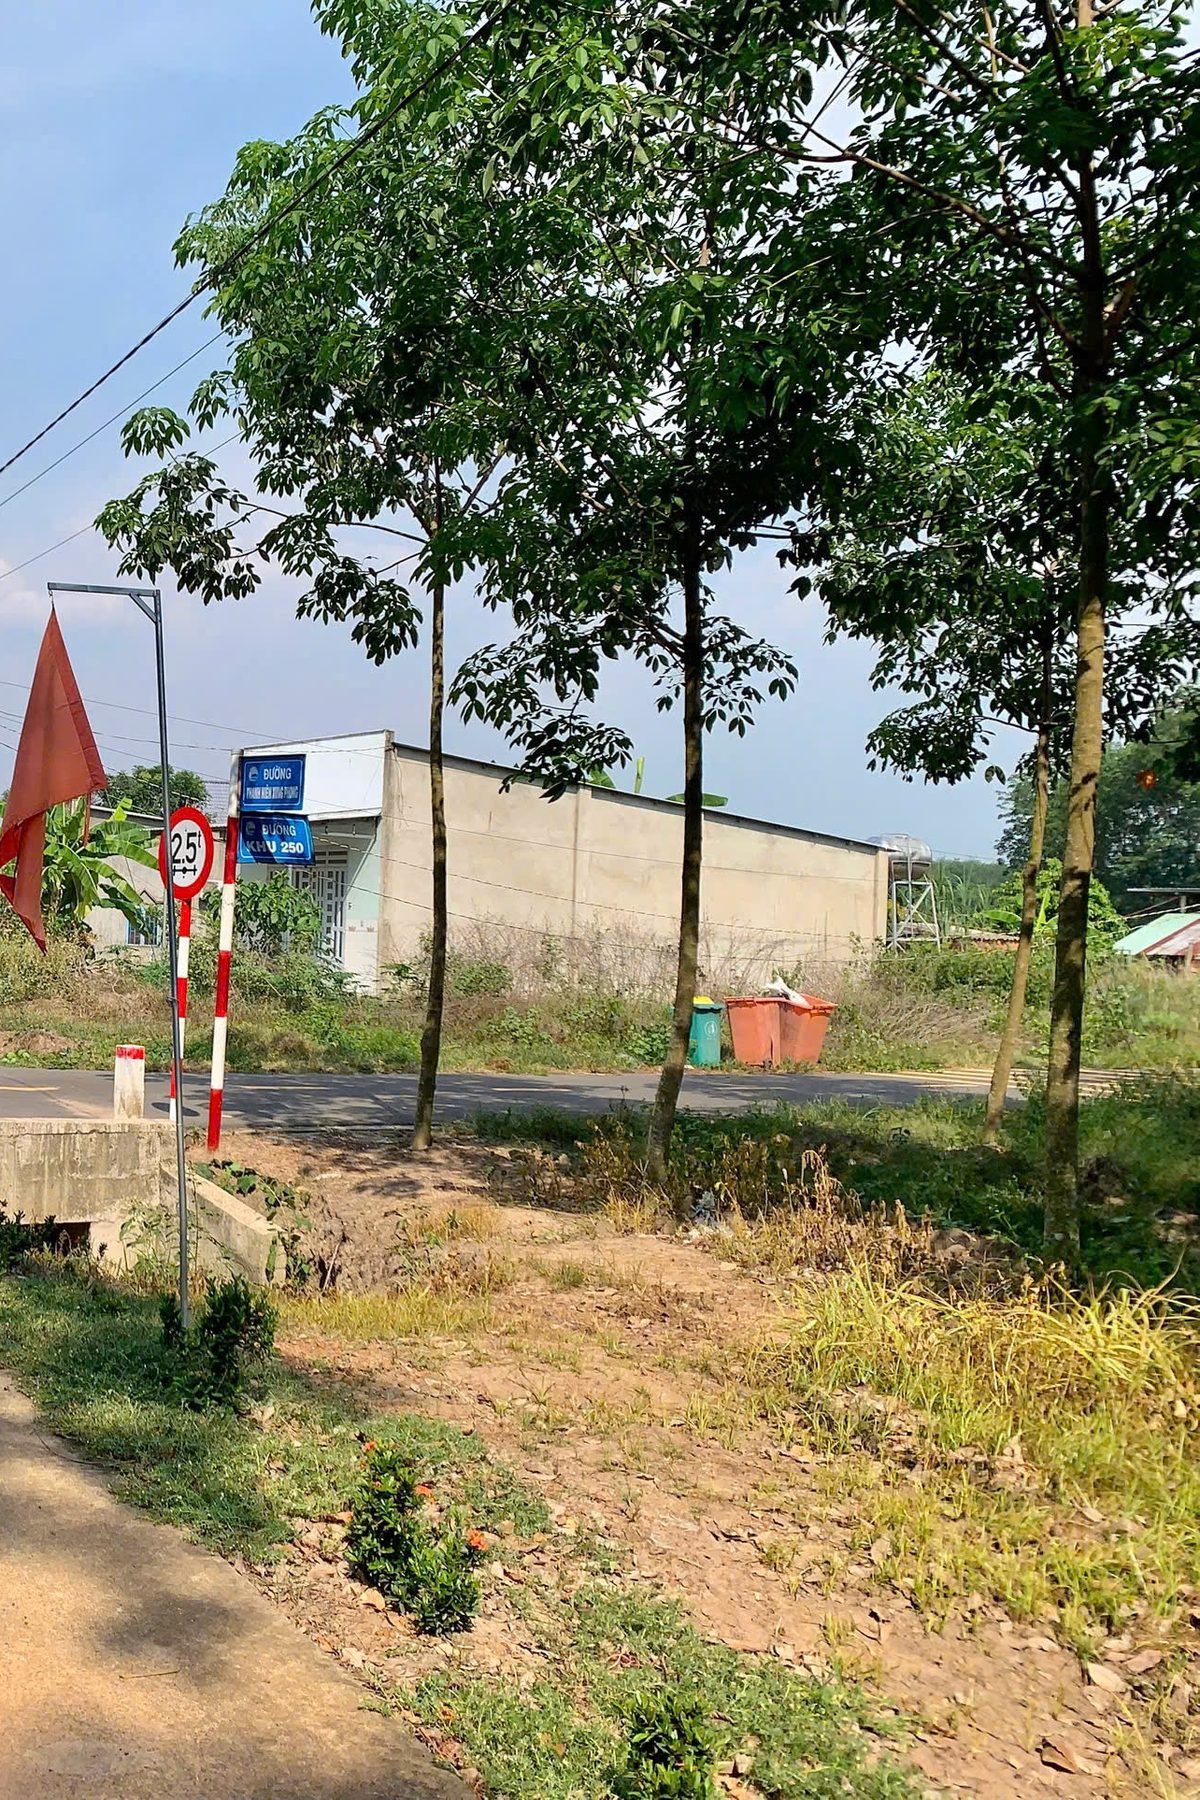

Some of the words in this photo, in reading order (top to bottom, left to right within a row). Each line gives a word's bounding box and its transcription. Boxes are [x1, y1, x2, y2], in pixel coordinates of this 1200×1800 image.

[263, 765, 292, 780] ĐƯỜNG
[247, 840, 277, 853] KHU
[281, 842, 304, 854] 250
